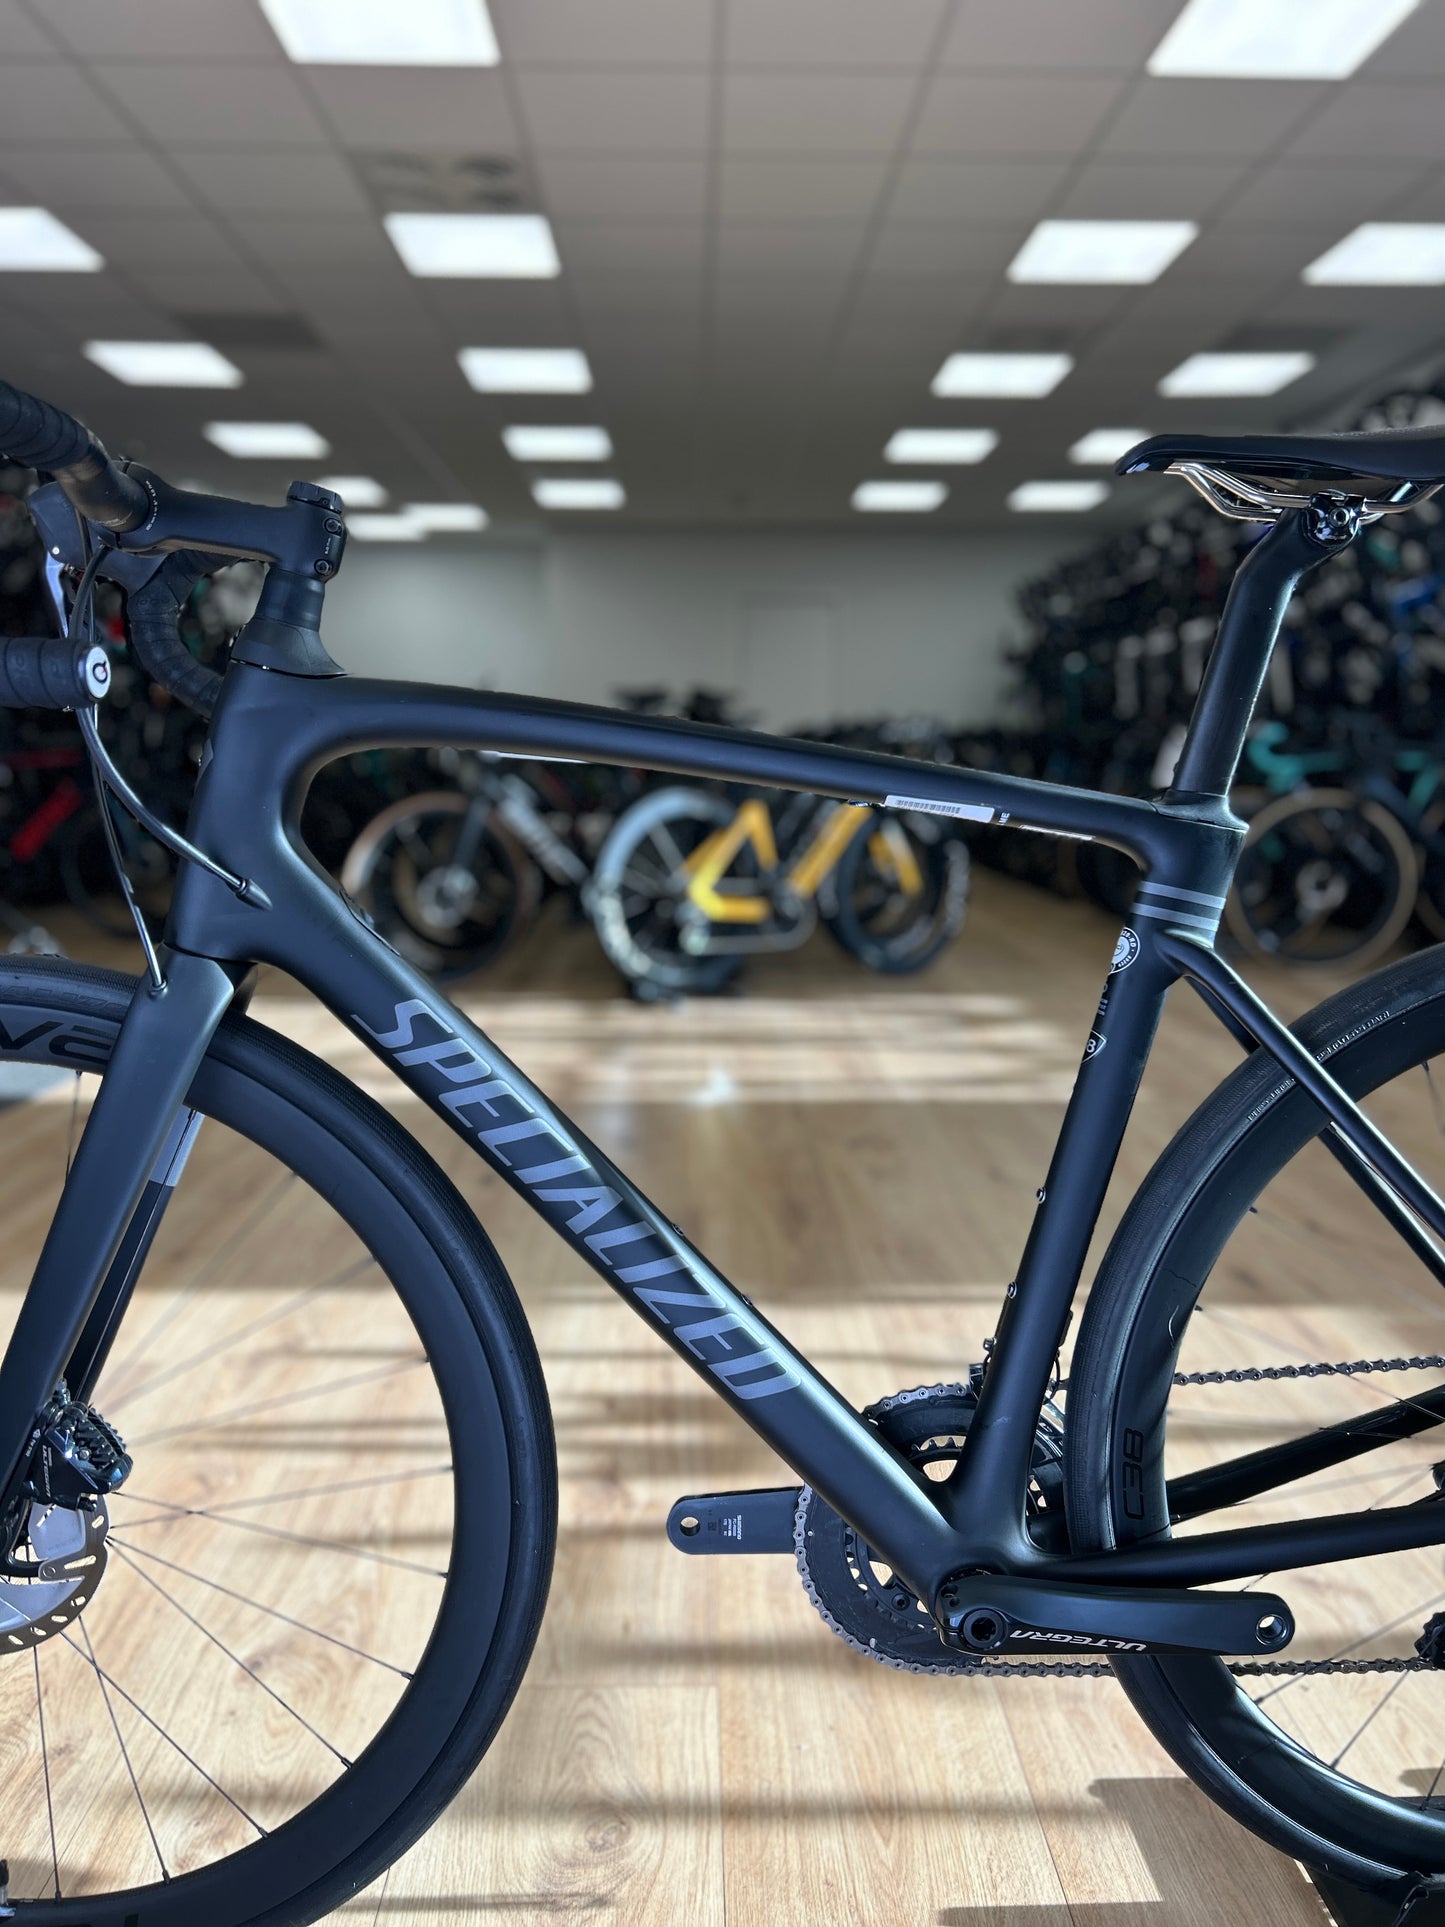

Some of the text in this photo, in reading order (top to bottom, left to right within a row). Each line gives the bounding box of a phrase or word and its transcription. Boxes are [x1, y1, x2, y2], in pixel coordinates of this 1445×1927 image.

[351, 998, 801, 1401] SPECIALIZED
[42, 1444, 51, 1498] ULTEGRA
[1122, 1427, 1145, 1521] C38
[1009, 1629, 1148, 1652] ULTEGRA
